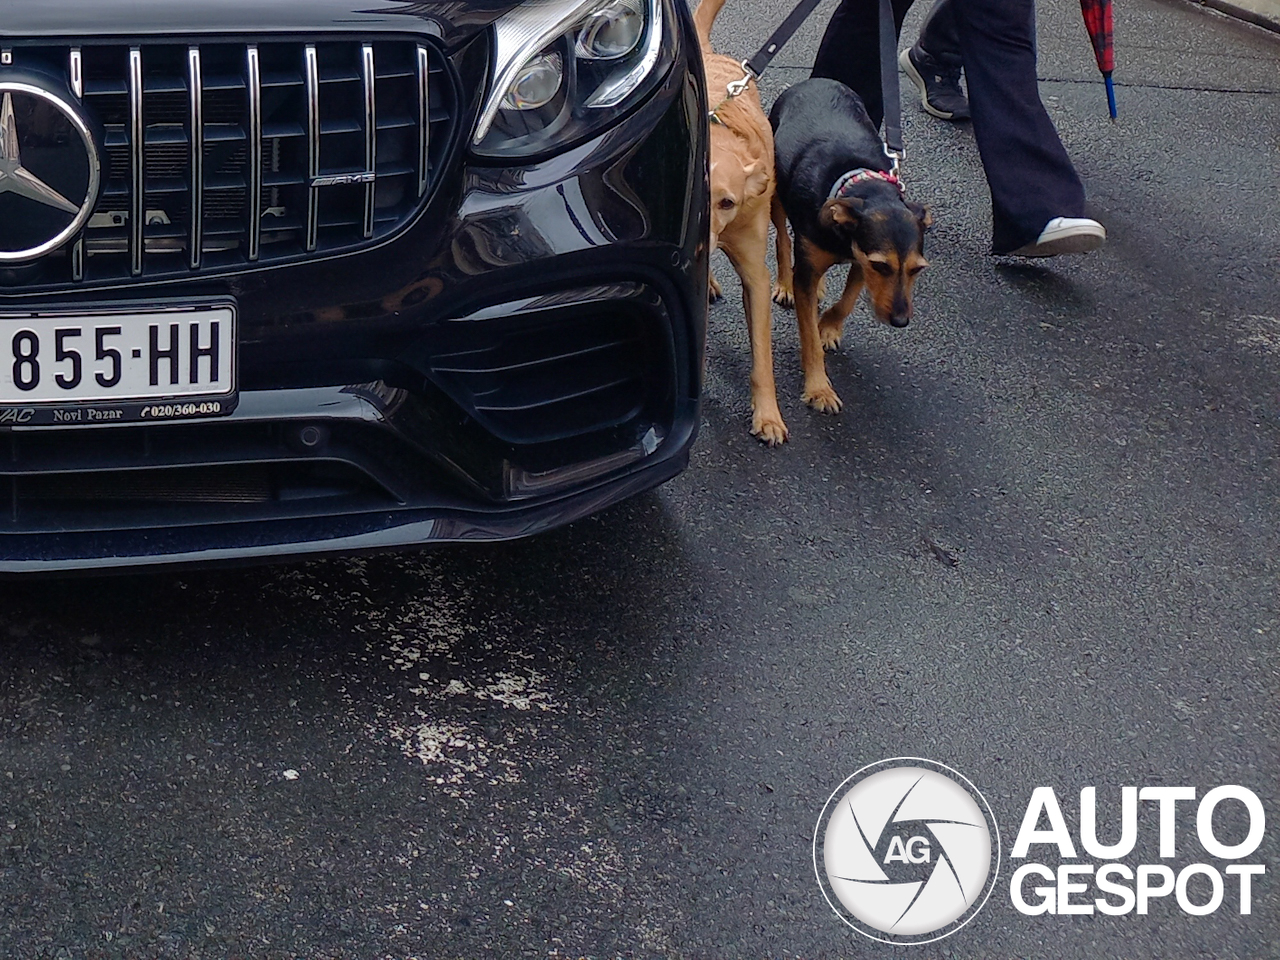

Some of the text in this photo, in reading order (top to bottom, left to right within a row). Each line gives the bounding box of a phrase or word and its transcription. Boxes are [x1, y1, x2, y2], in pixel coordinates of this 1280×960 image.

[53, 409, 82, 422] Novi
[87, 408, 123, 421] Pazar
[150, 401, 221, 417] 020/360-030
